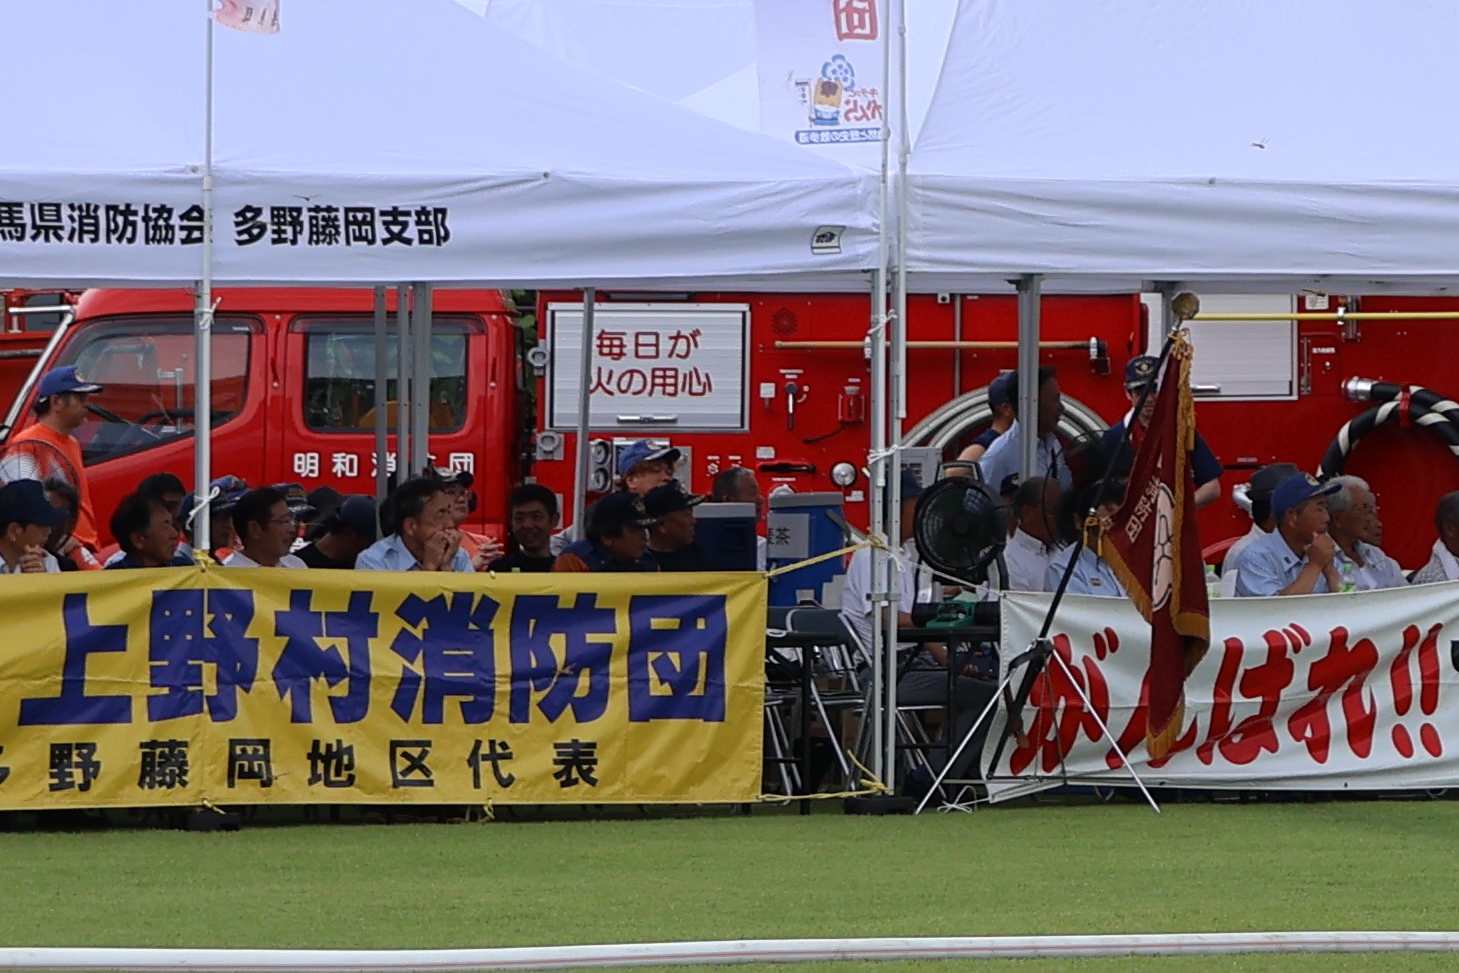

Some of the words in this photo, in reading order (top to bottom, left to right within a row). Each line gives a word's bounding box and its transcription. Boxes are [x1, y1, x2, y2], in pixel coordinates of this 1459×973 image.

[233, 204, 451, 247] 多野藤岡支部
[596, 328, 702, 361] 毎日が
[587, 366, 713, 397] 火の用心
[293, 452, 474, 478] 明和消団
[17, 588, 728, 727] 上野村消防団
[0, 738, 600, 793] 野藤岡地区代表
